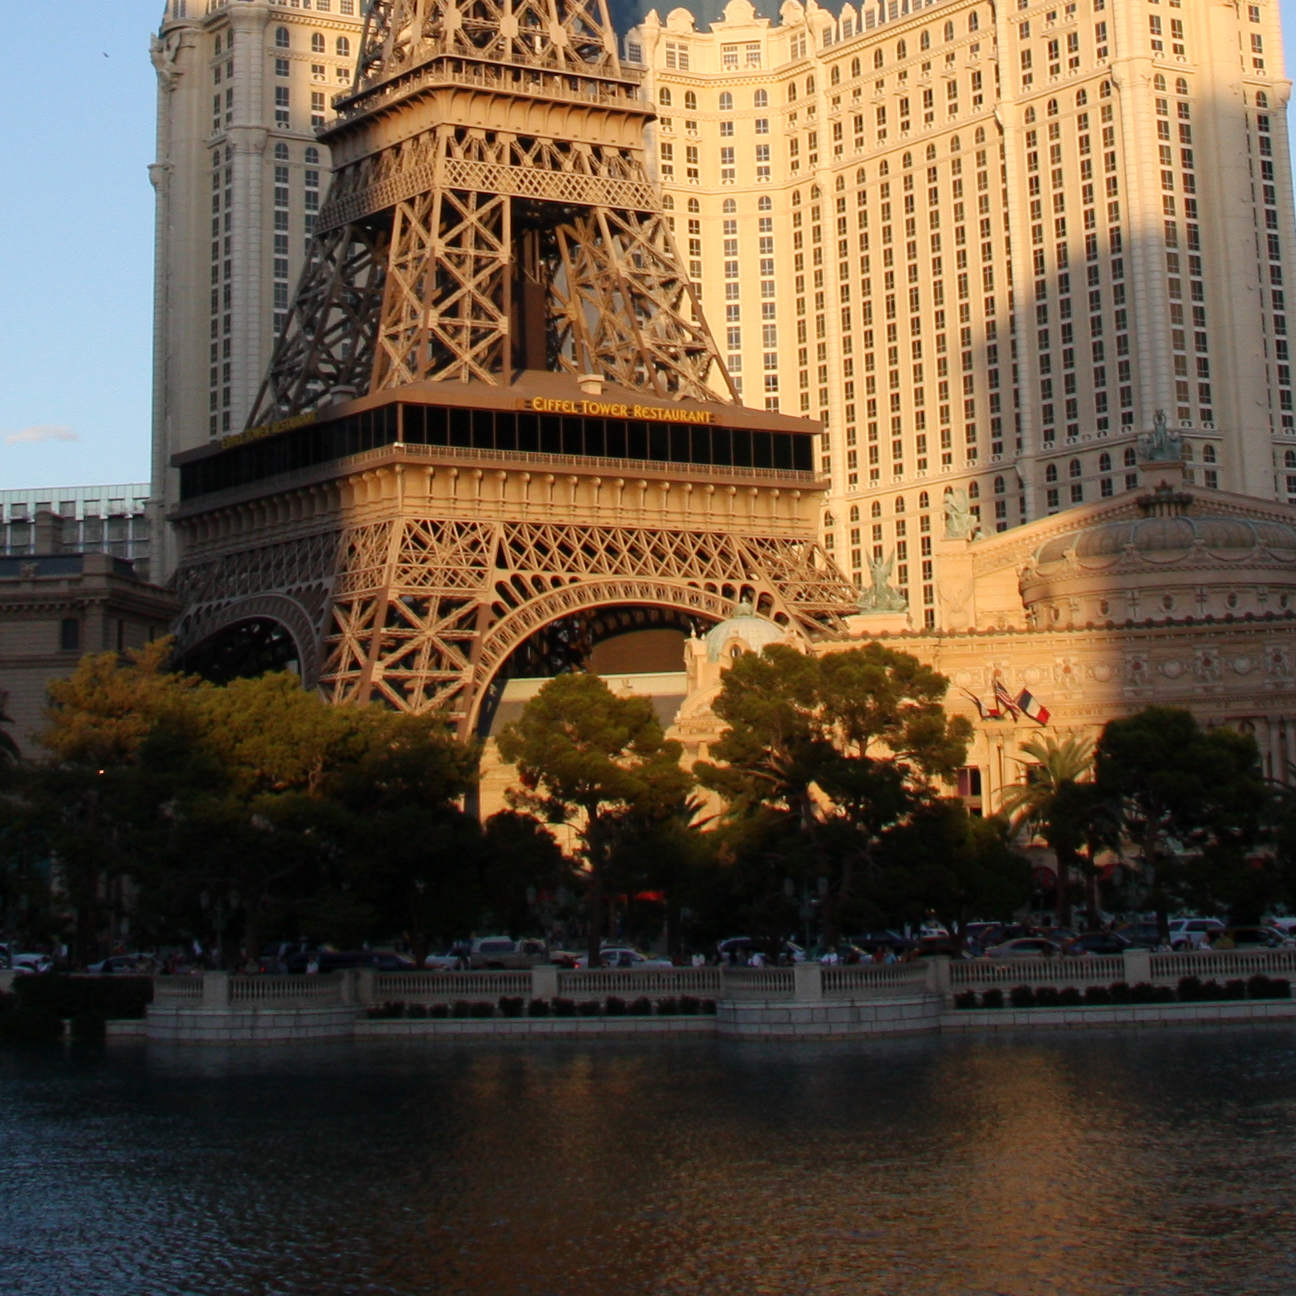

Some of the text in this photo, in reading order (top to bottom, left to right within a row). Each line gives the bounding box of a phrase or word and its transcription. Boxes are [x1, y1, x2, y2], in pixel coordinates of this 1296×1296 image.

[532, 396, 712, 423] EIFFEL TOWER RESTAURANT
